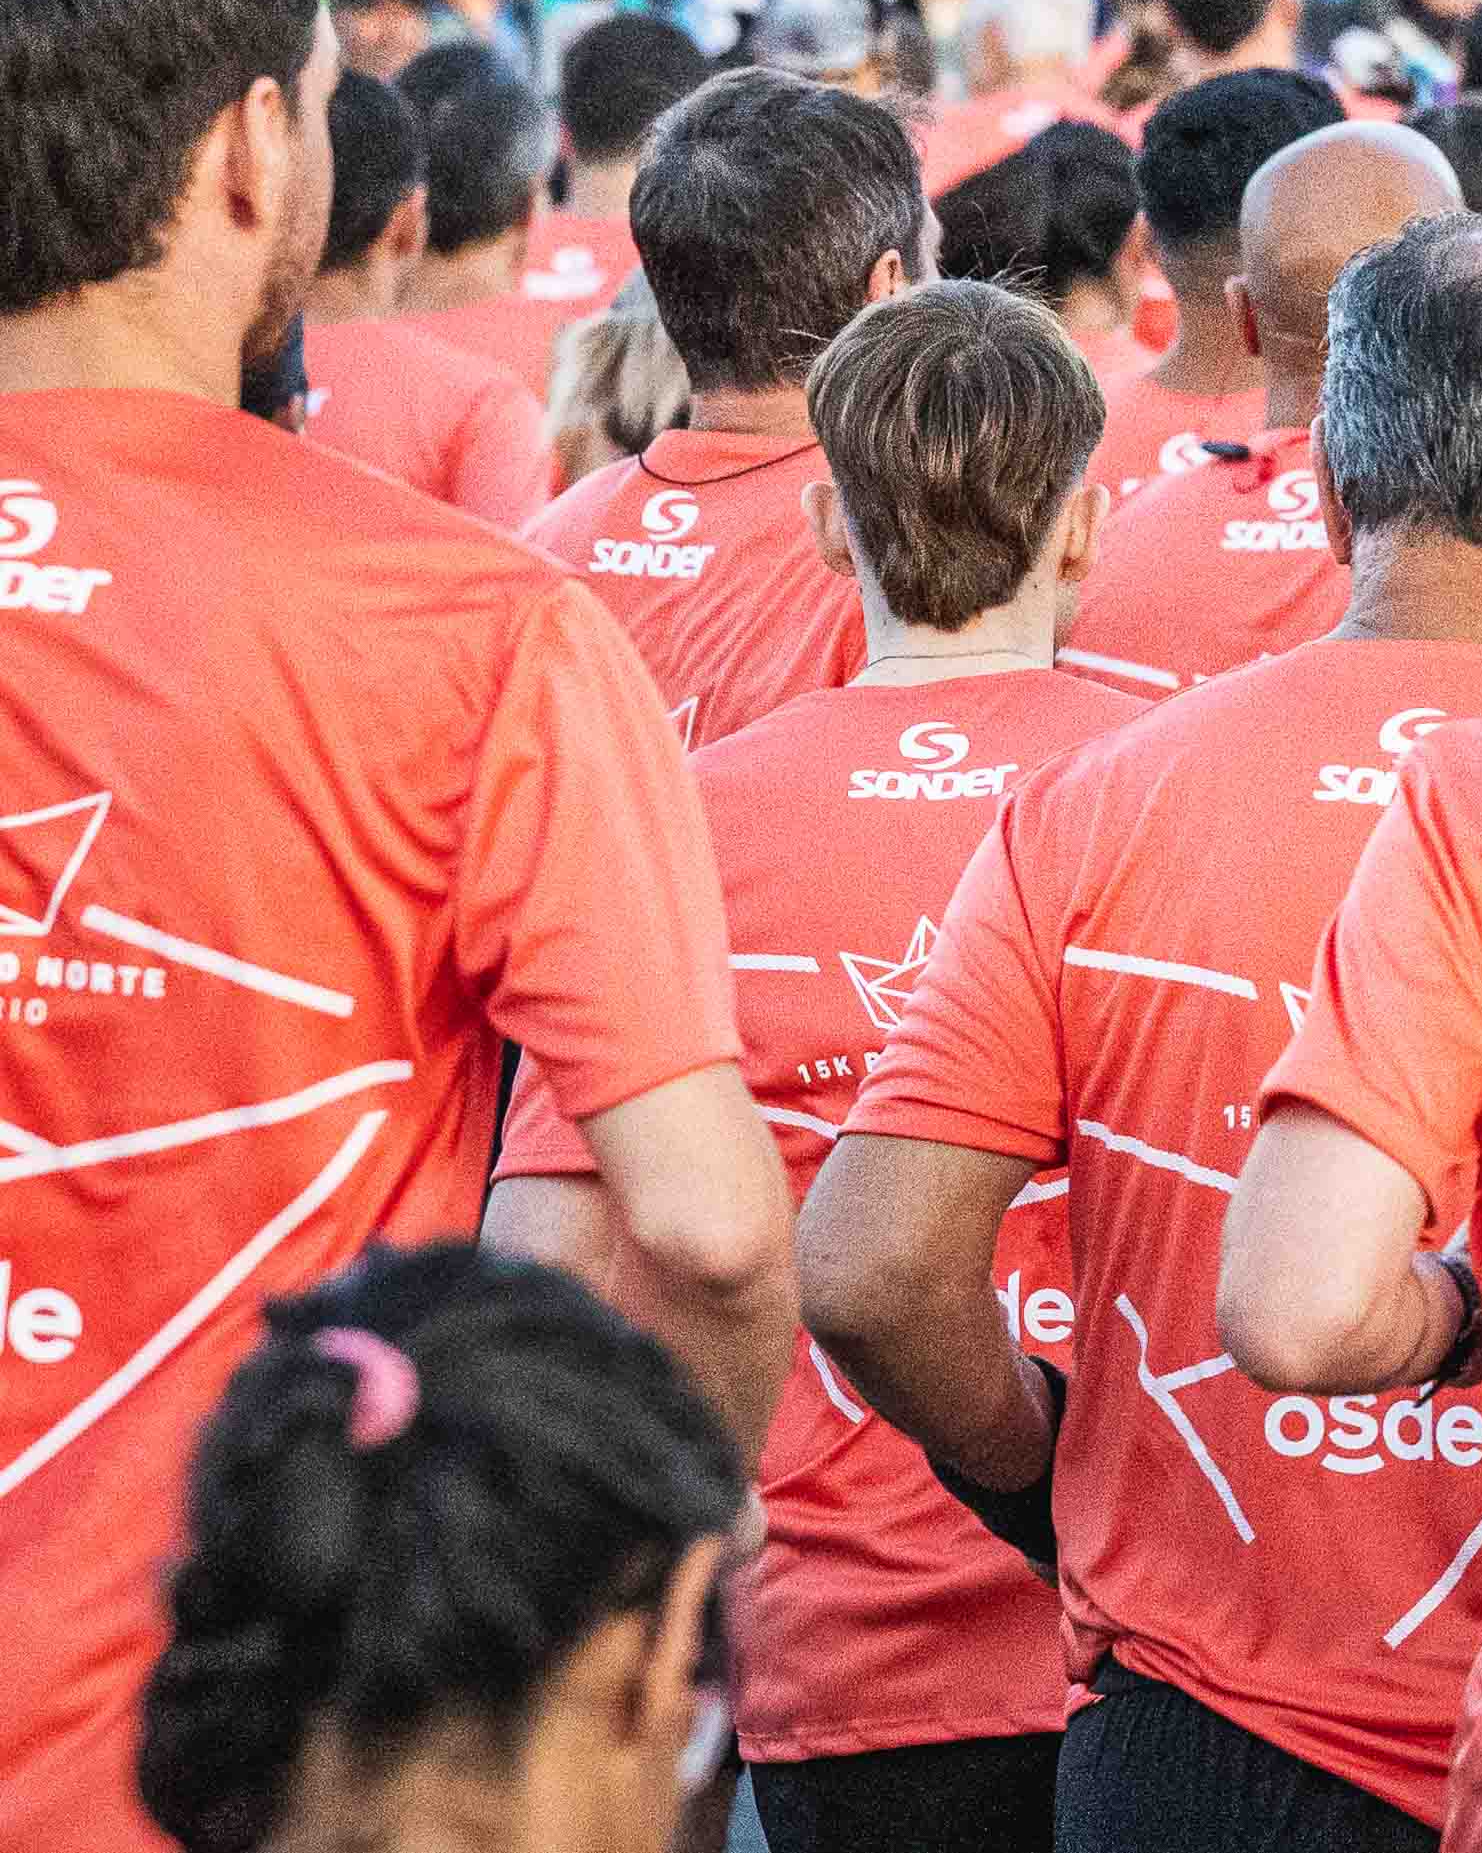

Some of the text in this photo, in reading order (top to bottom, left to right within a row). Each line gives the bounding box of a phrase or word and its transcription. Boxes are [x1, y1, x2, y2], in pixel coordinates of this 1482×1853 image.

[36, 954, 167, 1000] NORTE
[797, 1053, 853, 1084] 15K
[1223, 1105, 1252, 1130] 15
